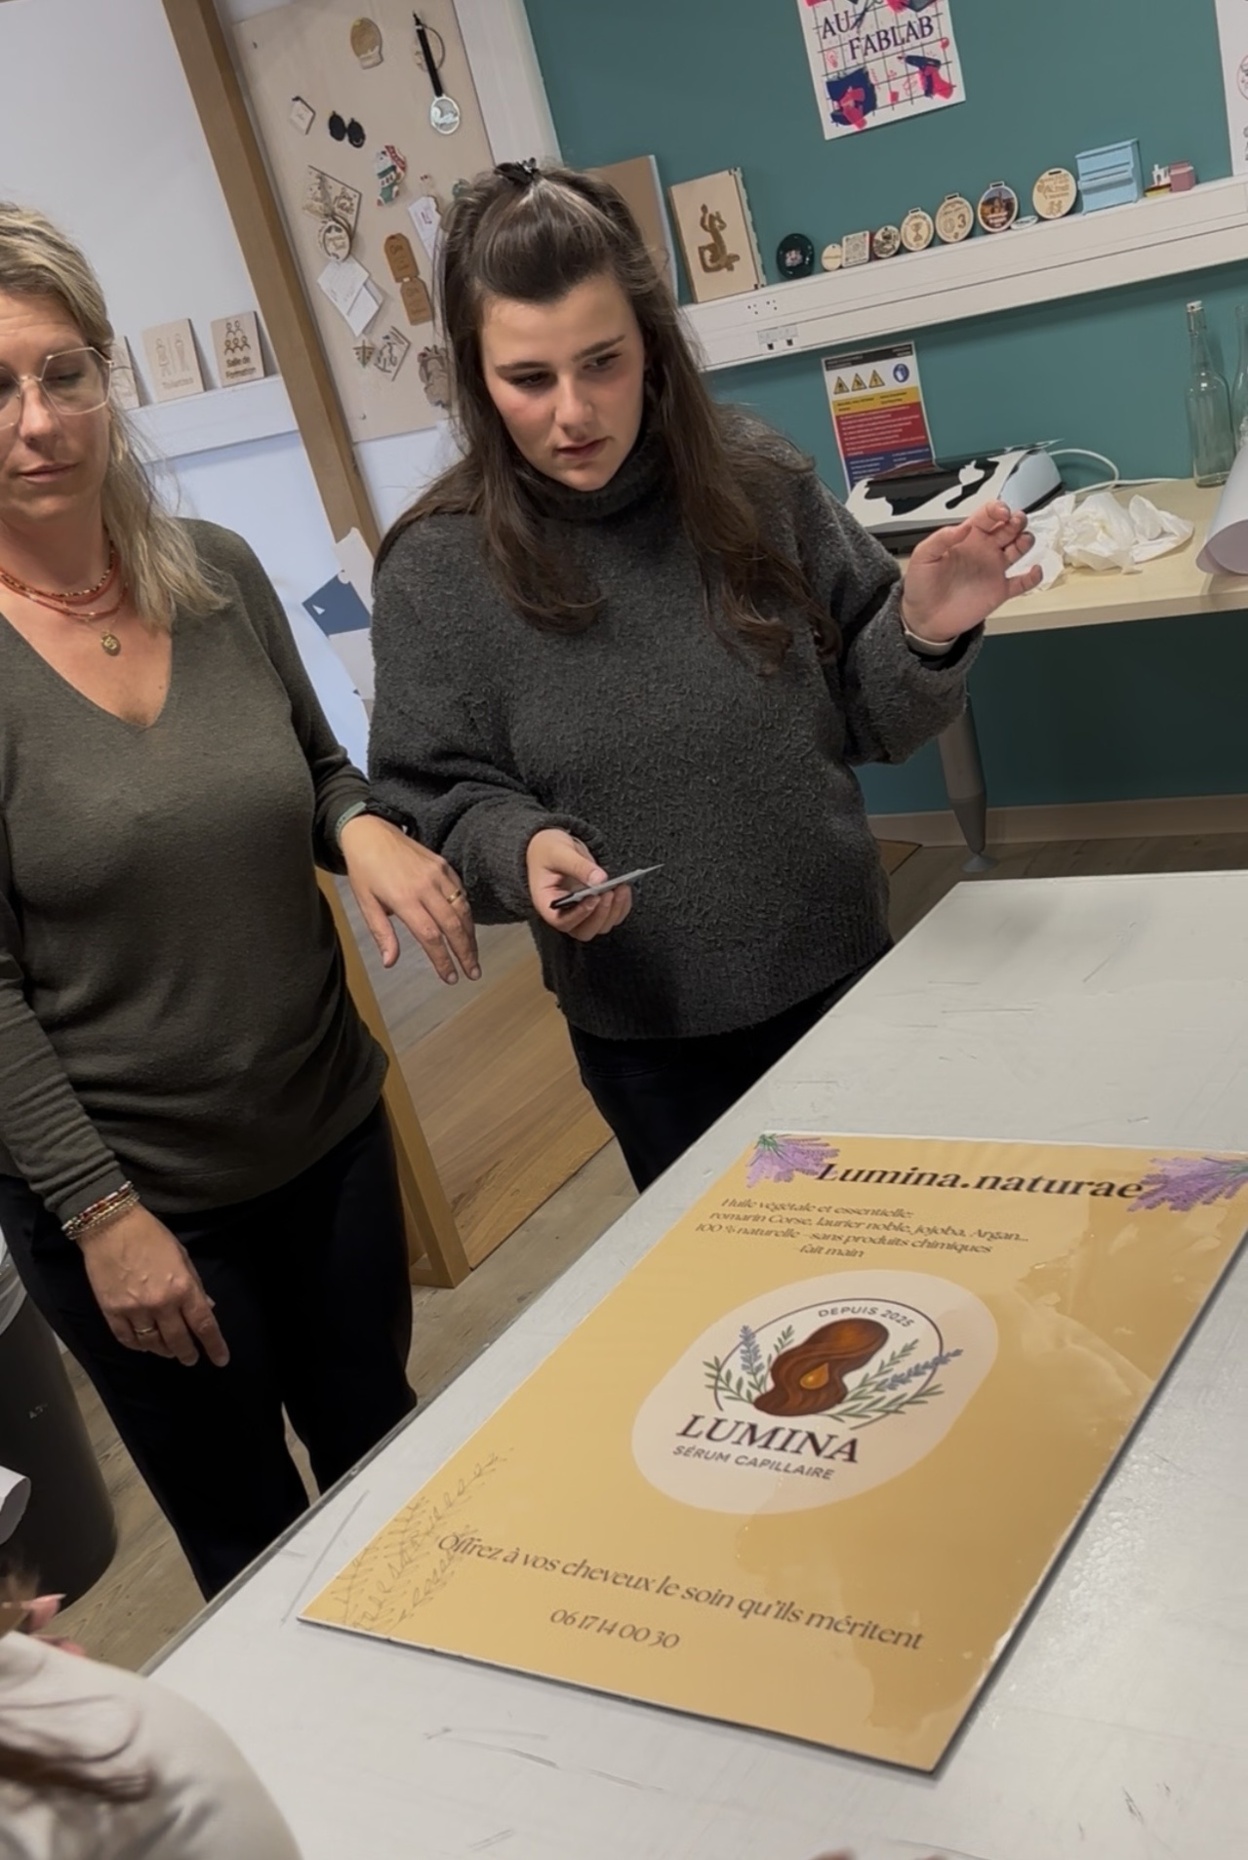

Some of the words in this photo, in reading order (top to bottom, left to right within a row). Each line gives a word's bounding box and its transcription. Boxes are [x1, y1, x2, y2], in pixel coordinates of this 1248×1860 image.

[822, 11, 850, 39] AU
[848, 15, 934, 60] FABLAB
[816, 1163, 1144, 1199] Lumina.naturae
[709, 1212, 767, 1222] romarin
[815, 1216, 866, 1230] laurier
[817, 1205, 833, 1213] et
[695, 1223, 723, 1233] 100
[736, 1227, 801, 1239] naturelle
[842, 1233, 910, 1246] produits
[911, 1238, 993, 1254] chimiques
[824, 1247, 865, 1258] main
[818, 1306, 879, 1318] DEPUIS
[880, 1309, 915, 1328] 2025
[675, 1414, 859, 1463] LUMINA
[672, 1445, 732, 1463] SÉRUM
[734, 1455, 835, 1480] CAPILLAIRE
[437, 1534, 504, 1561] Offrez
[502, 1547, 520, 1564] à
[522, 1553, 561, 1572] vos
[561, 1559, 656, 1592] cheveux
[655, 1575, 680, 1597] le
[680, 1588, 734, 1609] soin
[804, 1611, 924, 1650] méritent
[549, 1608, 580, 1627] 06
[577, 1614, 600, 1631] 17
[596, 1618, 619, 1636] 14
[618, 1623, 651, 1643] 00
[650, 1630, 681, 1650] 30
